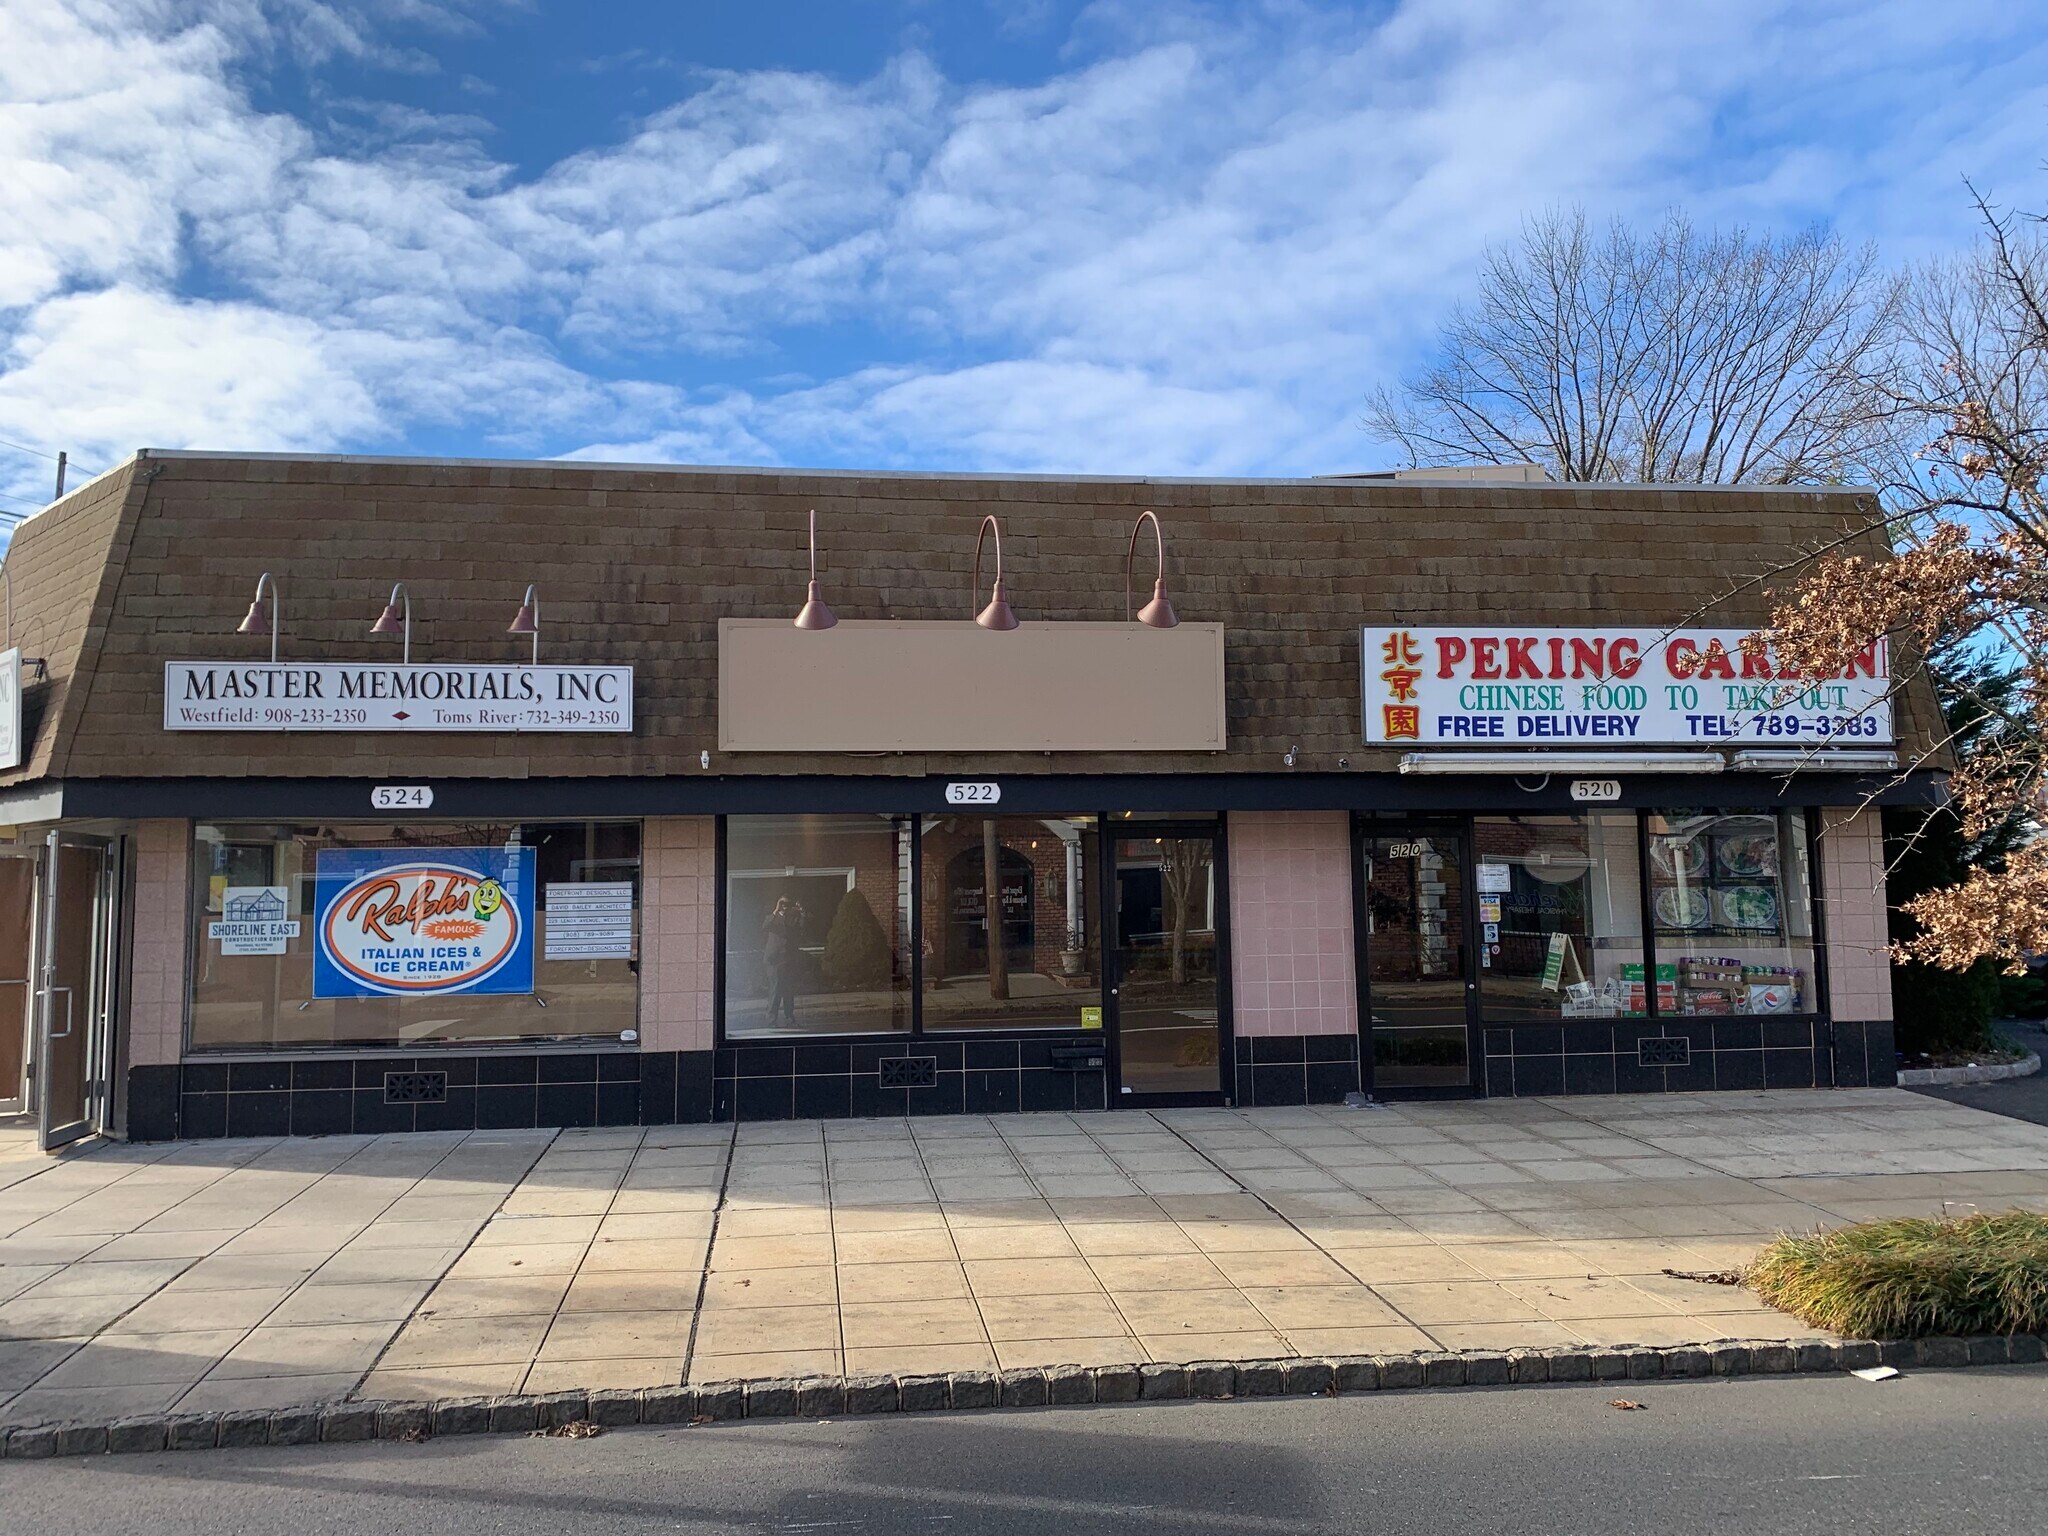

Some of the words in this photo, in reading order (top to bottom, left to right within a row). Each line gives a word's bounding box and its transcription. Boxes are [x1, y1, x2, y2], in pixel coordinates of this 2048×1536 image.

[1435, 636, 1642, 680] PEKING
[183, 669, 325, 700] MASTER
[336, 670, 543, 704] MEMORIALS,
[555, 673, 619, 703] INC
[1459, 684, 1565, 711] CHINESE
[1582, 684, 1648, 711] FOOD
[1664, 685, 1699, 711] TO
[1799, 685, 1849, 711] OUT
[179, 707, 259, 723] Westfield:
[264, 708, 367, 724] 908-233-2350
[432, 709, 472, 724] Toms
[479, 709, 524, 724] River:
[526, 710, 620, 725] 732-349-2350
[1437, 715, 1505, 737] FREE
[1517, 714, 1641, 737] DELIVERY
[1685, 715, 1740, 736] TEL:
[1753, 715, 1877, 737] 789-3383
[379, 788, 423, 805] 524
[953, 785, 993, 800] 522
[1579, 782, 1614, 797] 520
[1391, 845, 1421, 857] 520
[346, 876, 470, 943] Ralph's
[212, 924, 267, 936] SHORELINE
[270, 923, 297, 935] EAST
[434, 924, 475, 934] FAMOUS
[361, 948, 425, 960] ITALIAN
[431, 947, 467, 958] ICES
[472, 946, 482, 958] &
[374, 961, 400, 973] ICE
